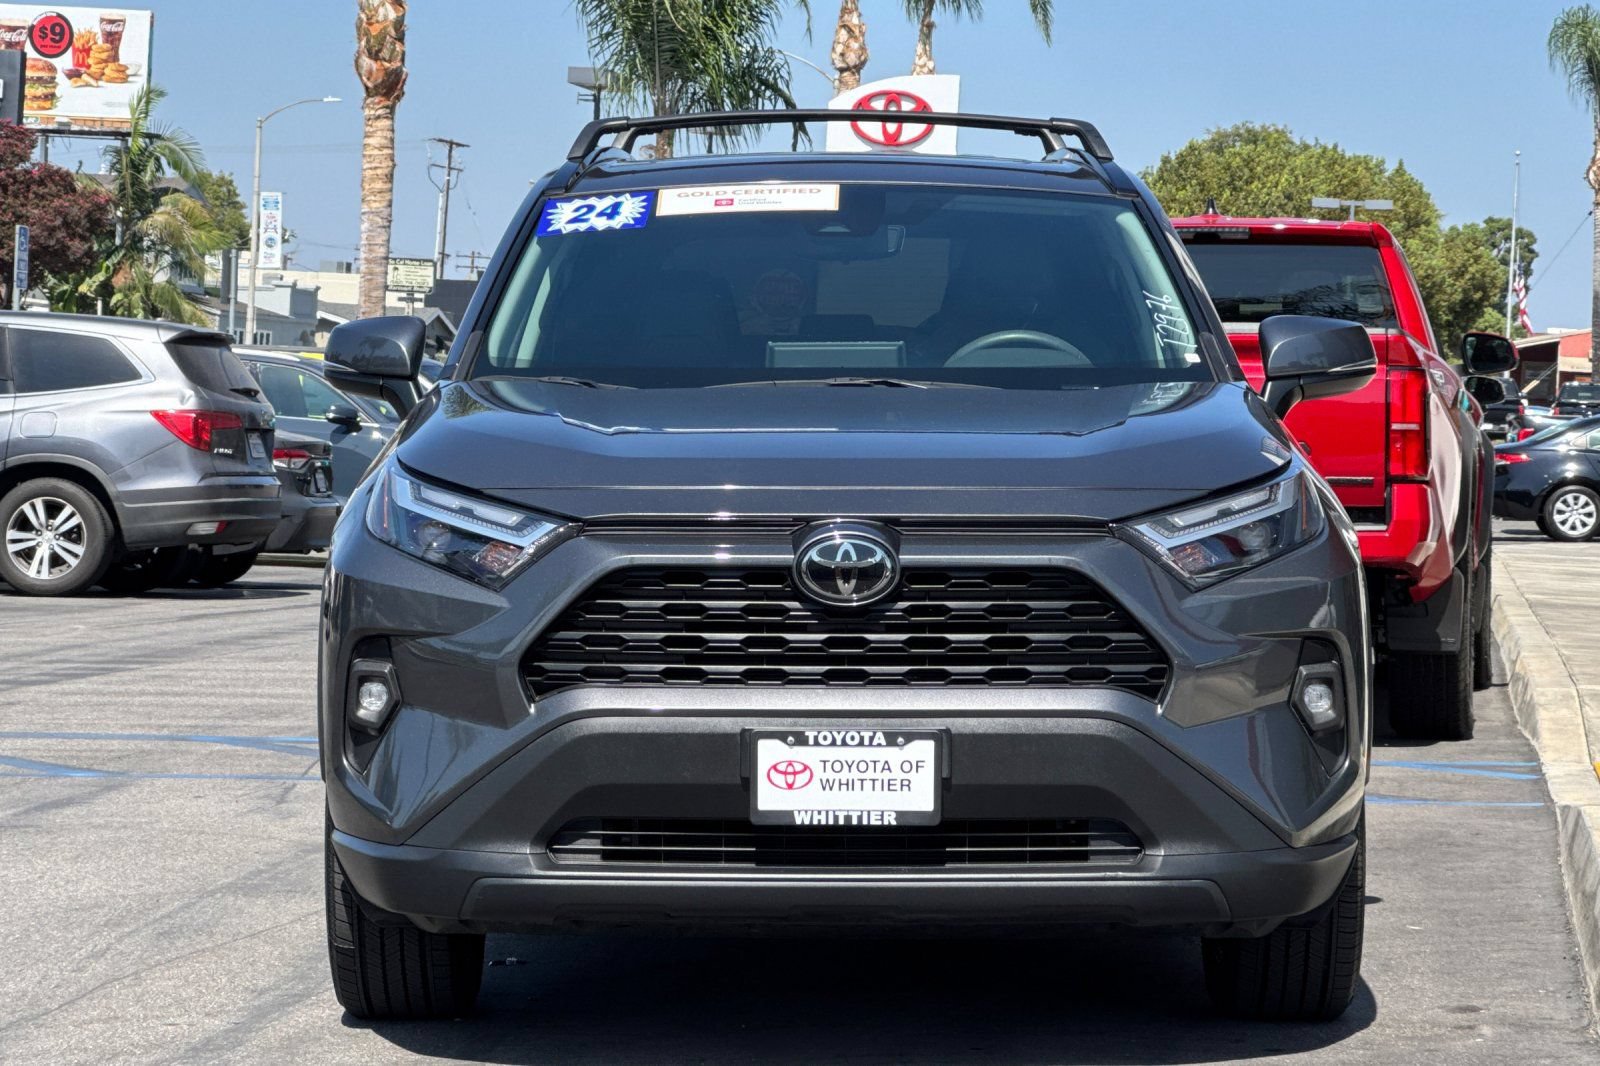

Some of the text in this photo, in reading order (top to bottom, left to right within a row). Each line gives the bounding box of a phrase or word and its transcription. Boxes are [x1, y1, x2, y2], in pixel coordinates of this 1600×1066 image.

[38, 22, 66, 44] $9
[676, 187, 821, 198] GOLD CERTIFIED
[565, 201, 624, 225] 24
[805, 731, 887, 746] TOYOTA
[819, 759, 926, 774] TOYOTA OF
[819, 778, 912, 792] WHITTIER
[793, 810, 897, 825] WHITTIER
